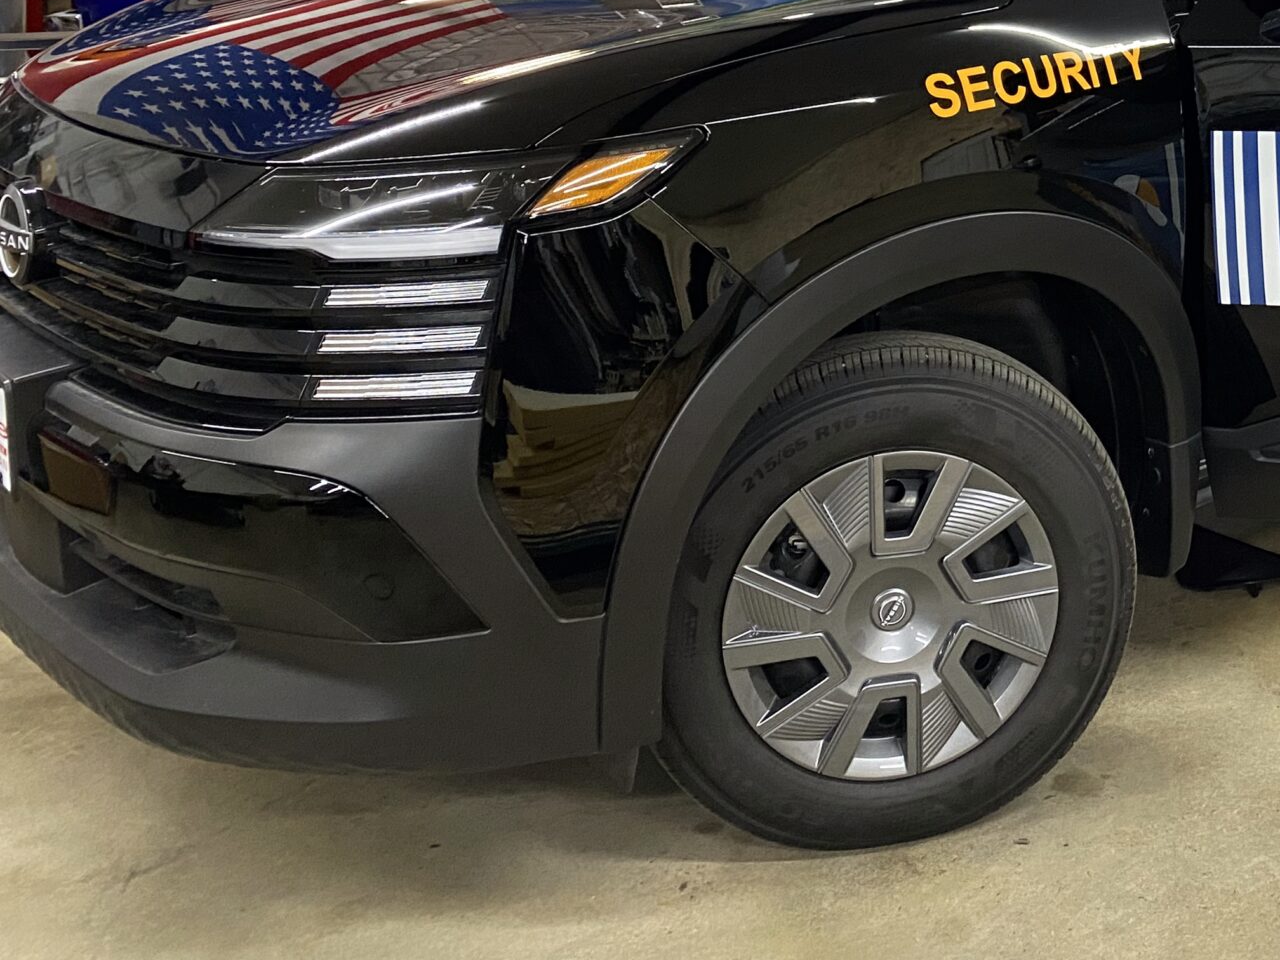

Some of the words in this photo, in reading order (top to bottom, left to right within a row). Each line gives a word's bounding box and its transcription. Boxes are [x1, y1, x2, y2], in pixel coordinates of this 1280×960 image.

[924, 45, 1143, 119] SECURITY
[741, 435, 809, 494] 215/65
[814, 415, 857, 442] R16
